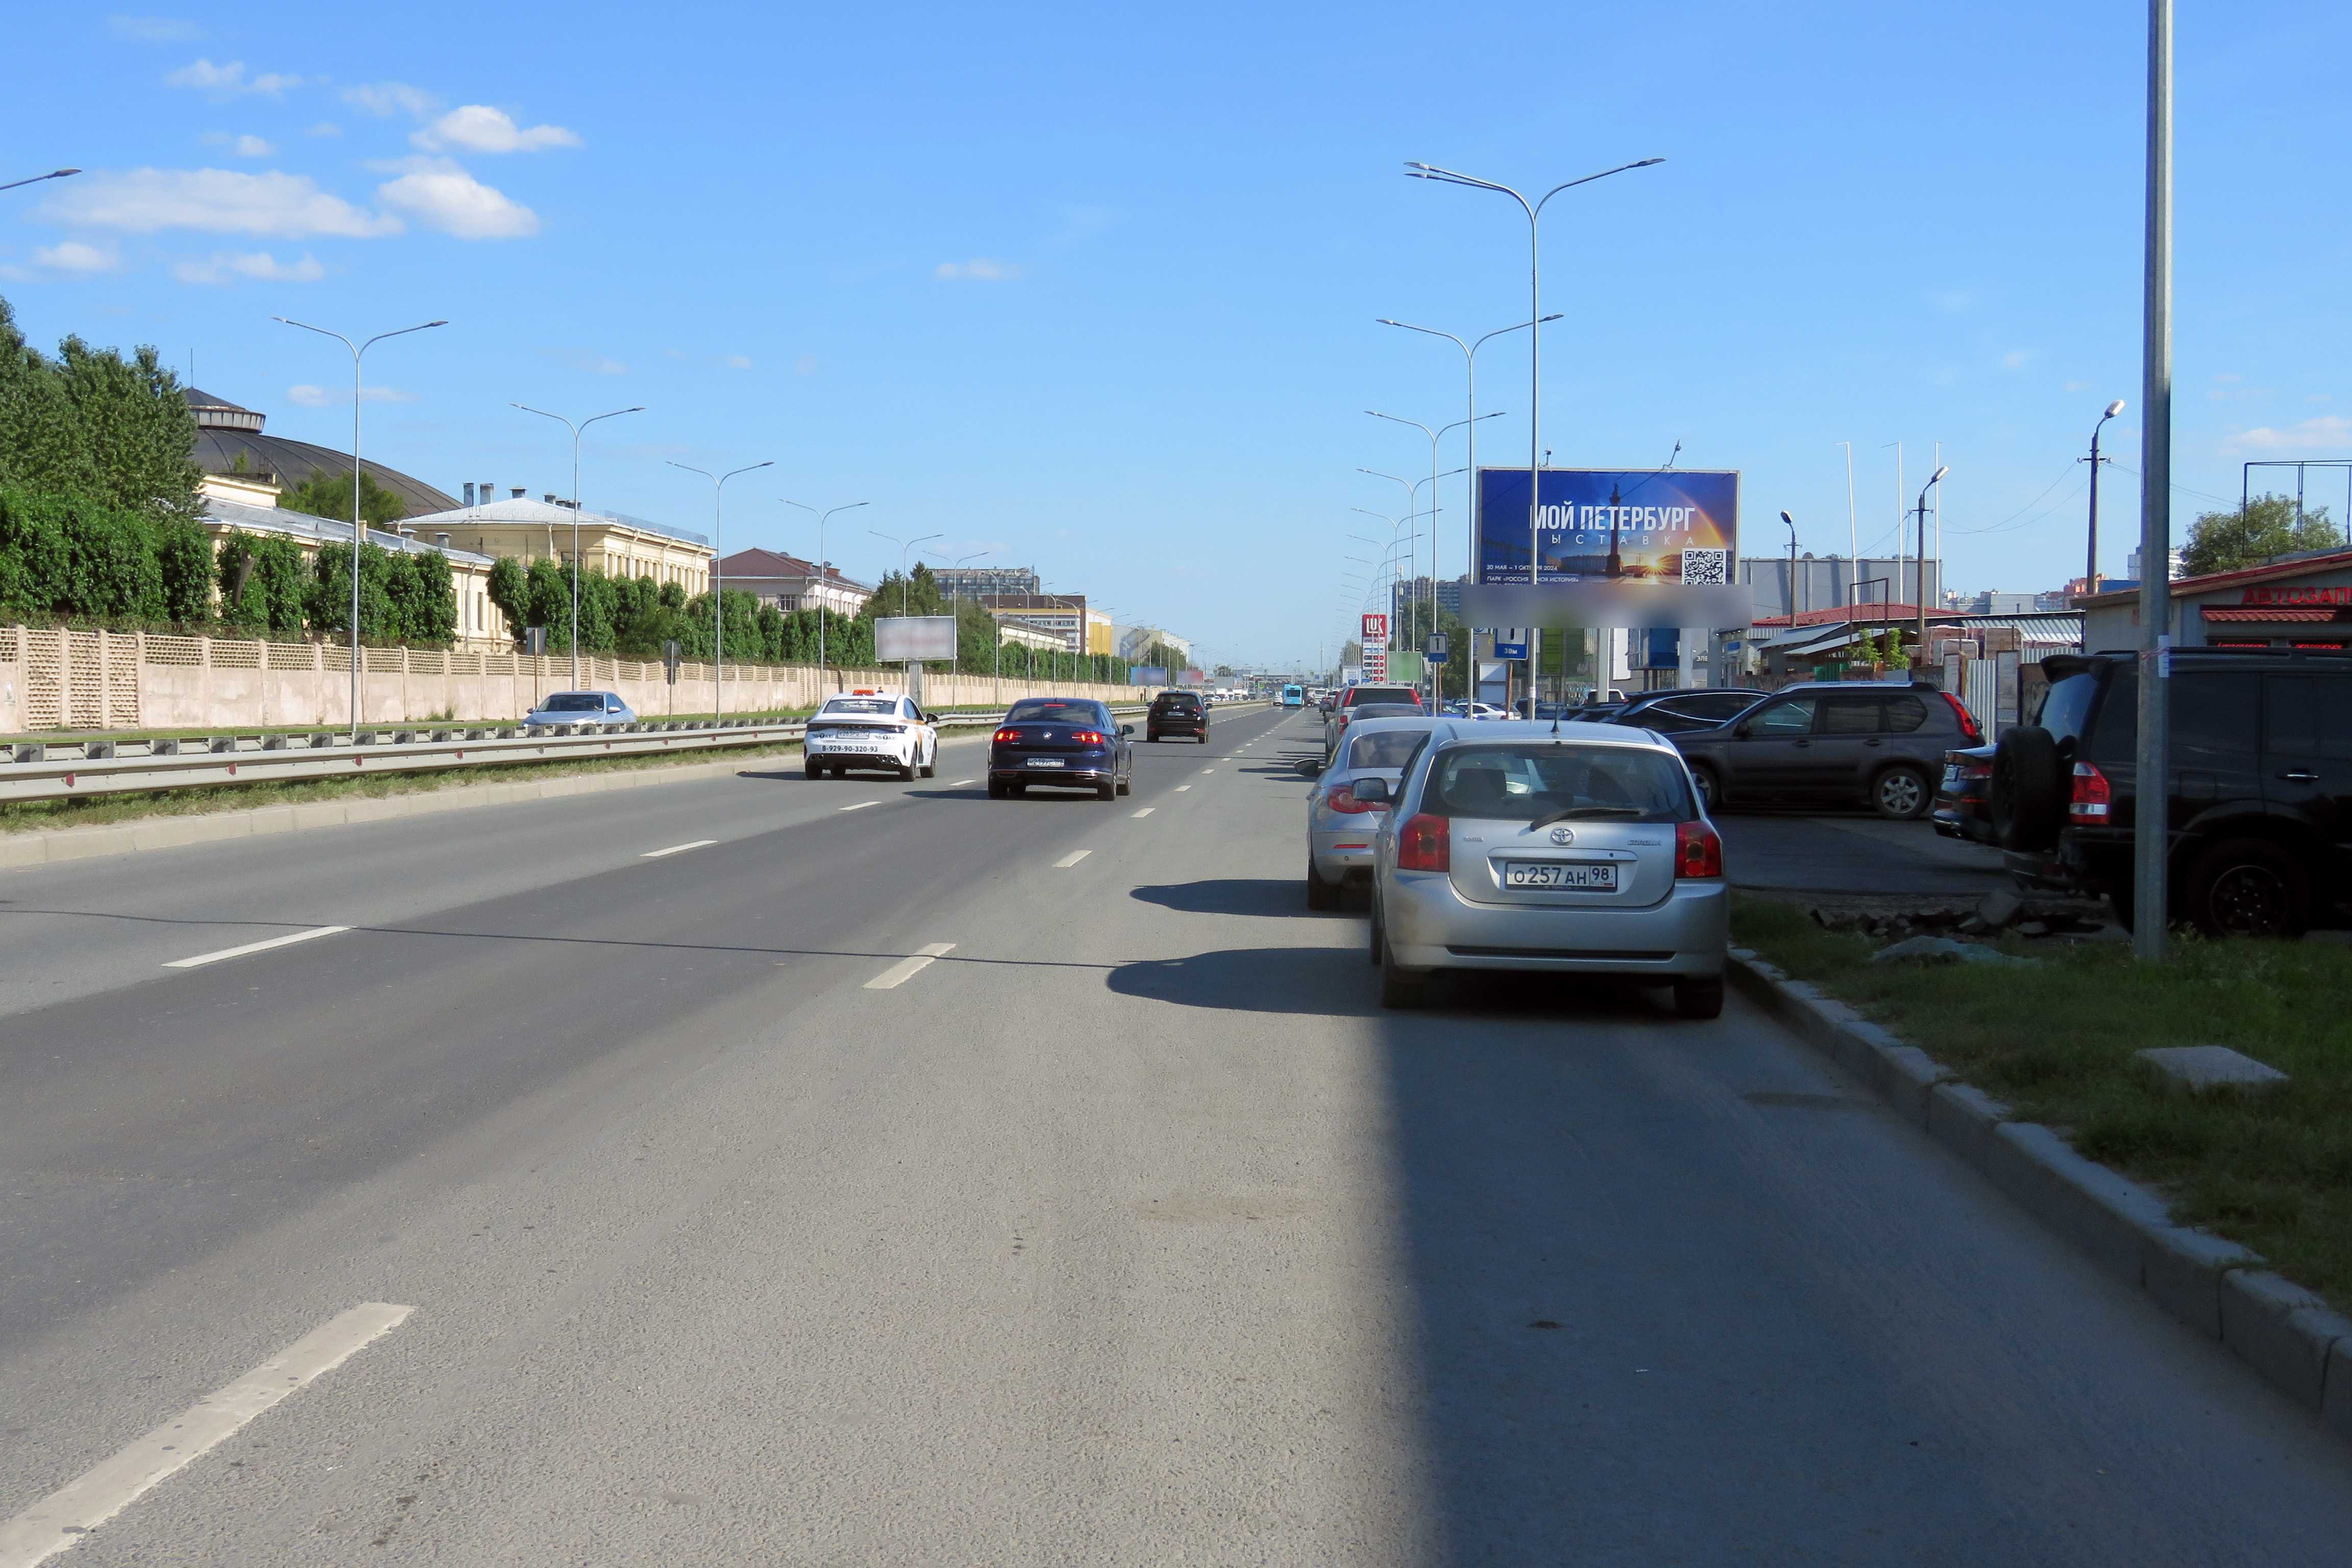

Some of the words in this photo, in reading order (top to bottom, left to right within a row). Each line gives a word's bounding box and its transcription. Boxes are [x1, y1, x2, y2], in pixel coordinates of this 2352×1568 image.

[1529, 500, 1574, 530] МОЙ
[1580, 506, 1695, 531] ПЕТЕРБУРГ
[1552, 534, 1694, 546] ЫСТАВКА
[2241, 586, 2352, 605] АВТОЗАП
[1592, 868, 1609, 880] 98
